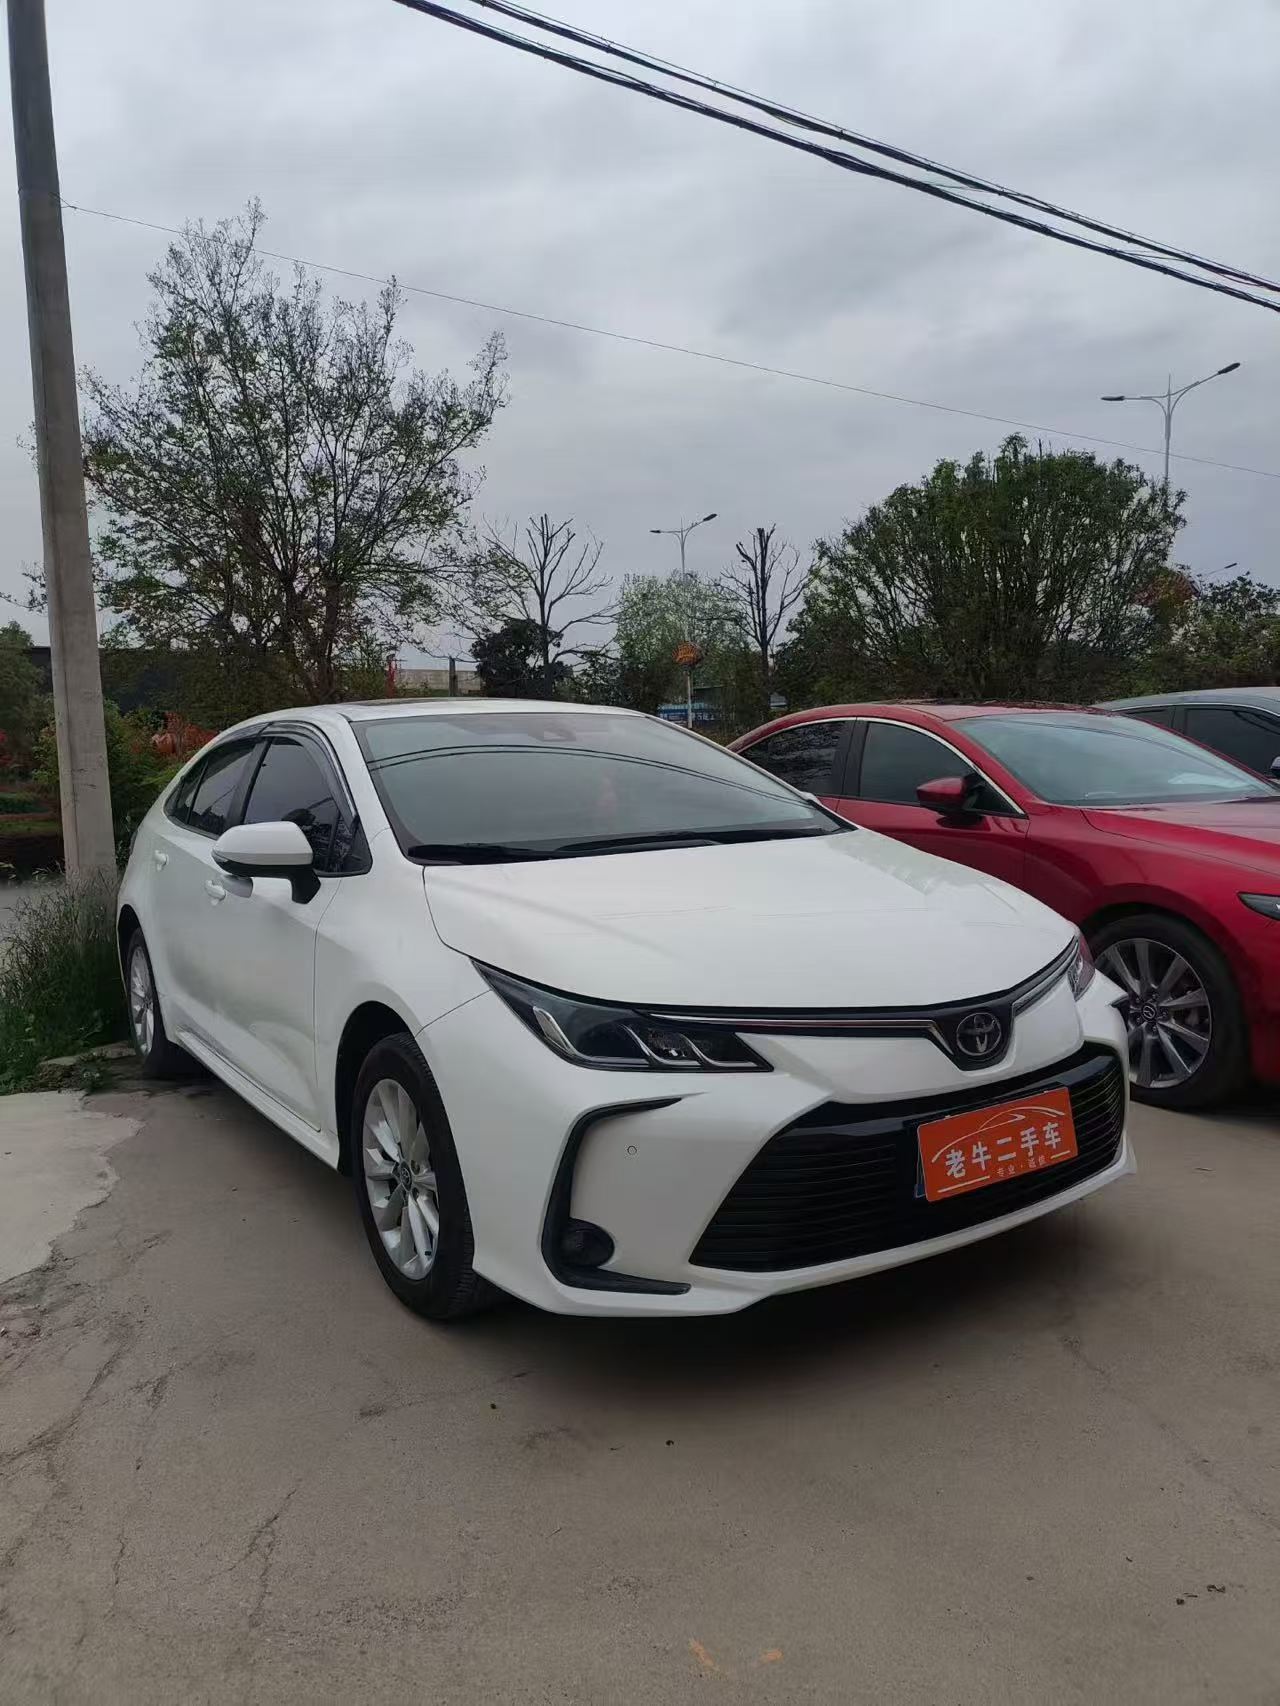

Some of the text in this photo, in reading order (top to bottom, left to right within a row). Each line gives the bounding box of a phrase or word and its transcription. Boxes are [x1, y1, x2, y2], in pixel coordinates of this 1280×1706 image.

[945, 1121, 1062, 1179] 老牛二手车
